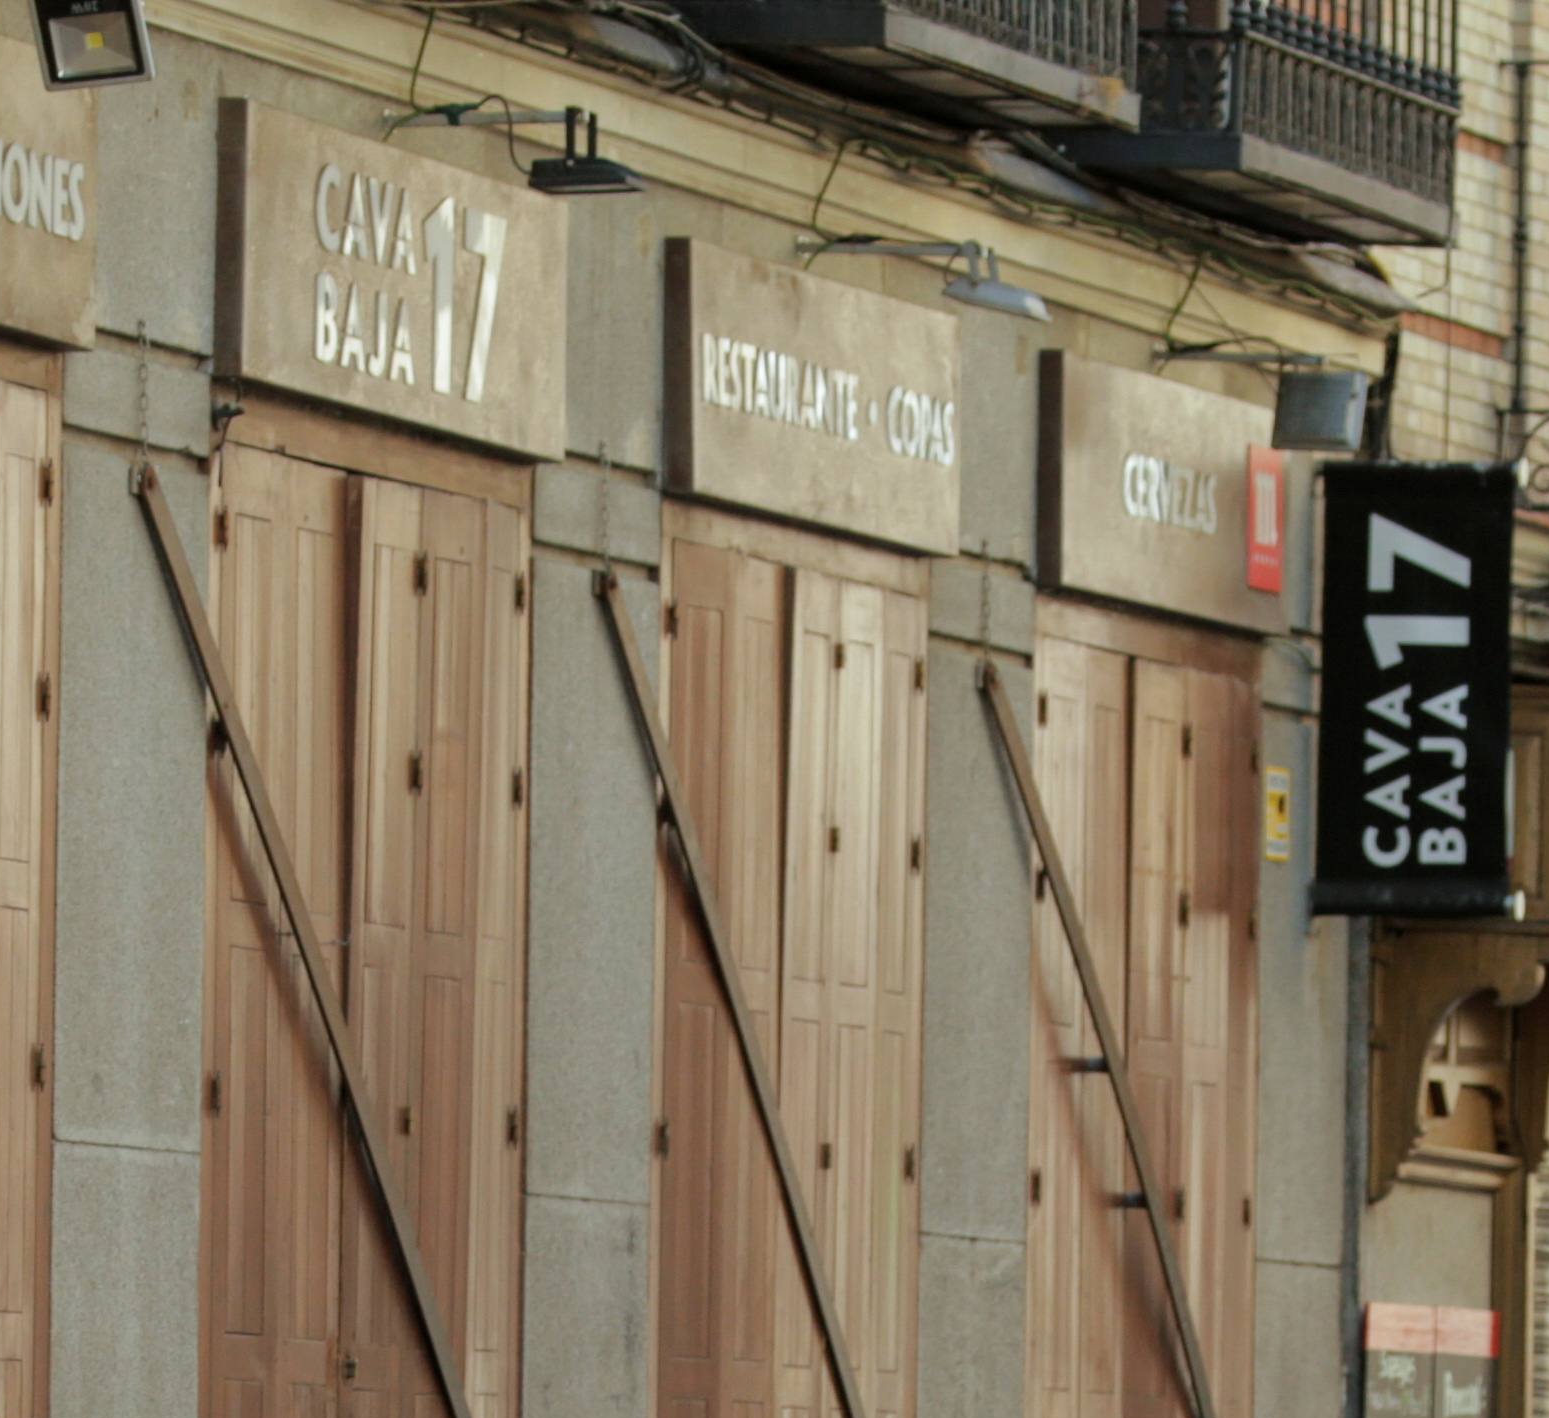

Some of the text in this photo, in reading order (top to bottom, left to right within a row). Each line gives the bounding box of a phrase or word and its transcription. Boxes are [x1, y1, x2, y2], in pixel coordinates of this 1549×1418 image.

[316, 163, 417, 276] CAVA
[314, 272, 416, 386] BAJA
[422, 196, 508, 401] 17
[700, 332, 956, 468] RESTAURANTE COPAS
[1123, 452, 1218, 536] CERVEZAS
[1363, 511, 1472, 670] 17
[1363, 684, 1411, 868] CAVA
[1418, 684, 1469, 865] BAJA
